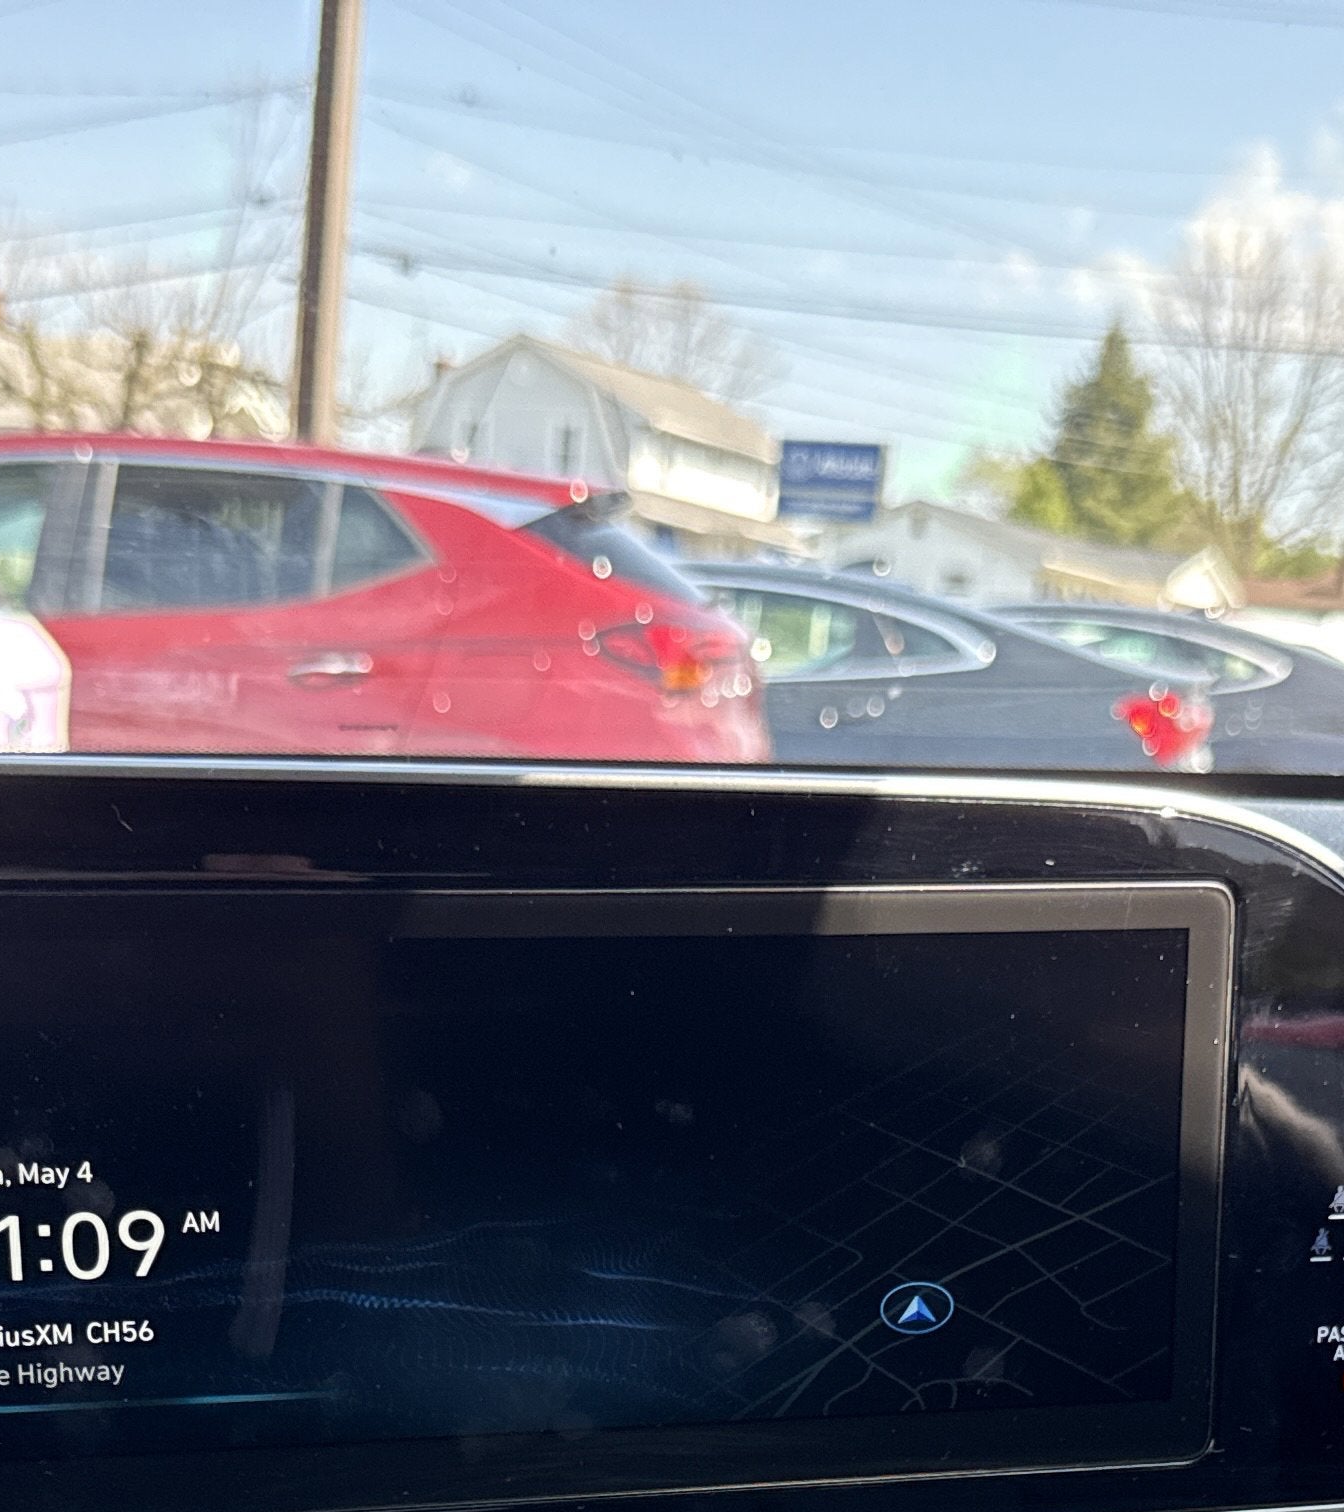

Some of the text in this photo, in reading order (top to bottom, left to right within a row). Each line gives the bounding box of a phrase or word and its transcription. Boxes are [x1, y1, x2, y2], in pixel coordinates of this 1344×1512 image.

[18, 1161, 70, 1189] May
[76, 1161, 94, 1184] 4
[182, 1211, 220, 1234] AM
[86, 1321, 154, 1345] CH56
[17, 1360, 125, 1390] Highway
